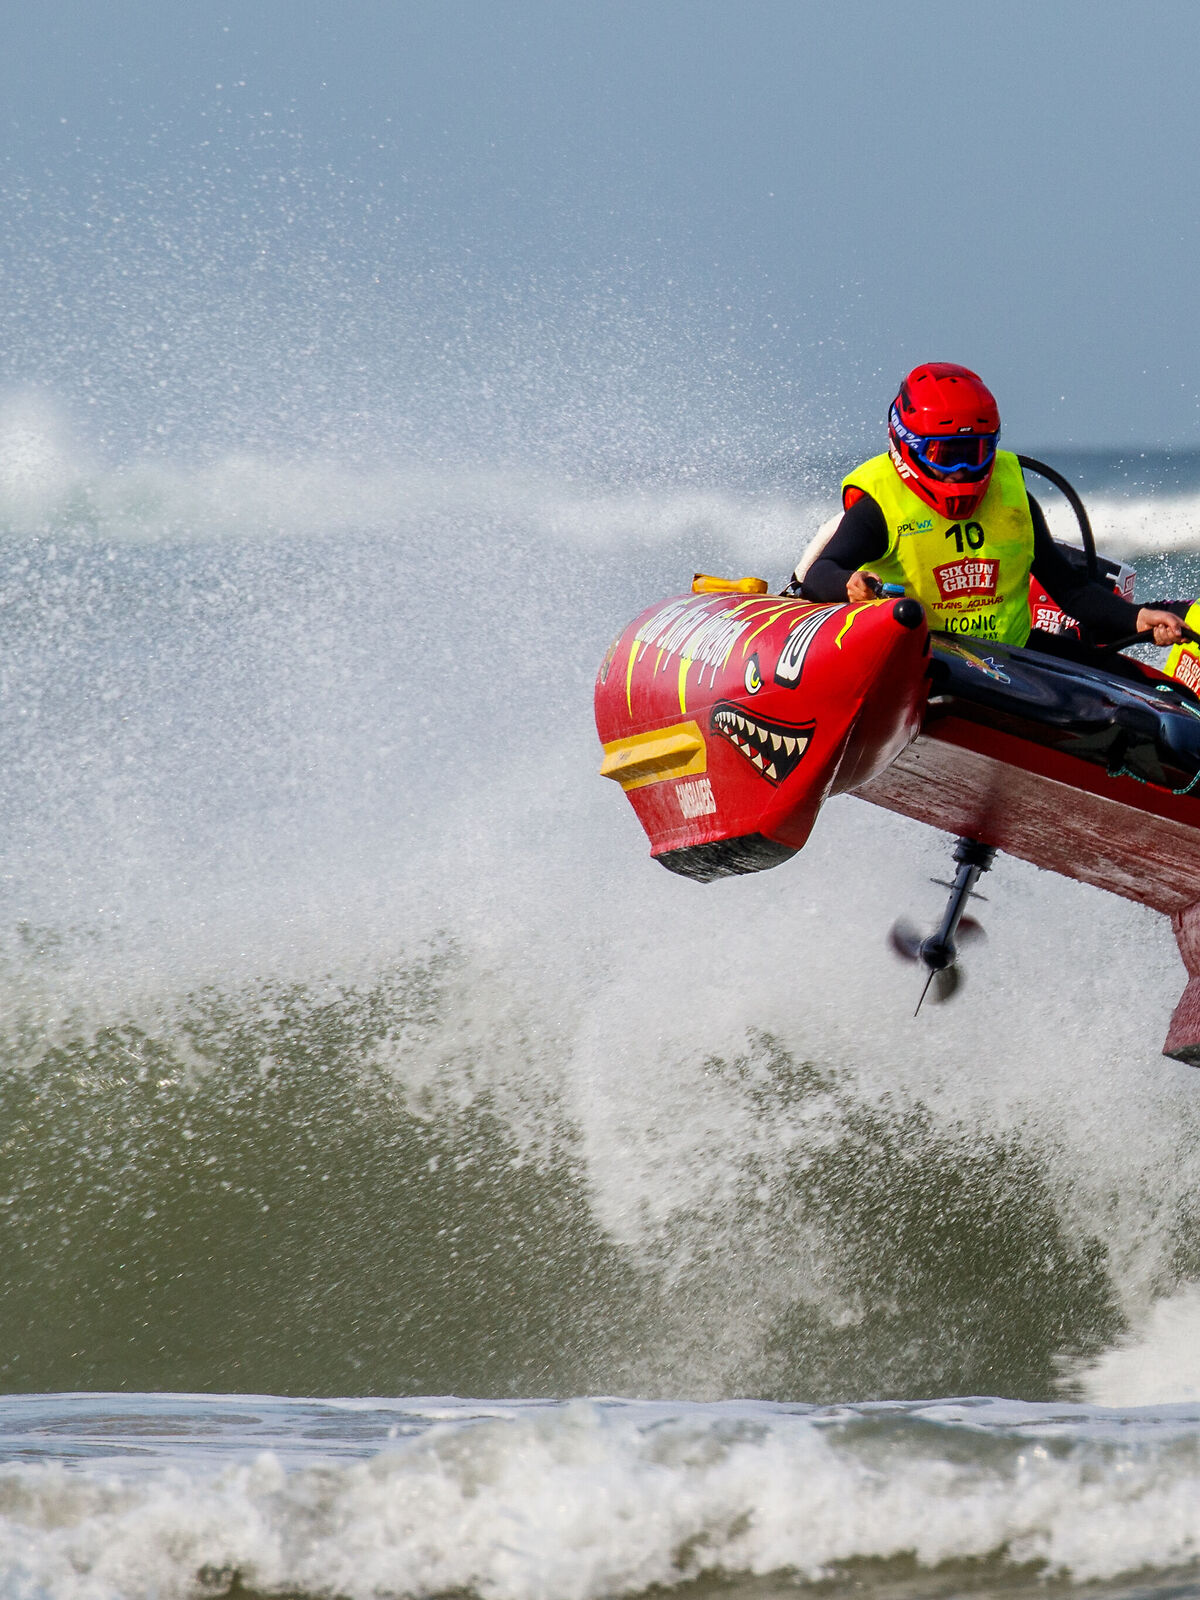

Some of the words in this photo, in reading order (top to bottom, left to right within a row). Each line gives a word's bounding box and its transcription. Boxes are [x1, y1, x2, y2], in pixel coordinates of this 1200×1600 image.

[945, 522, 985, 552] 10
[939, 565, 962, 580] SIX
[964, 563, 994, 575] GUN
[942, 574, 994, 593] GRILL
[932, 601, 962, 610] TRANS
[944, 614, 996, 632] ICONIC
[1037, 608, 1062, 622] SIX
